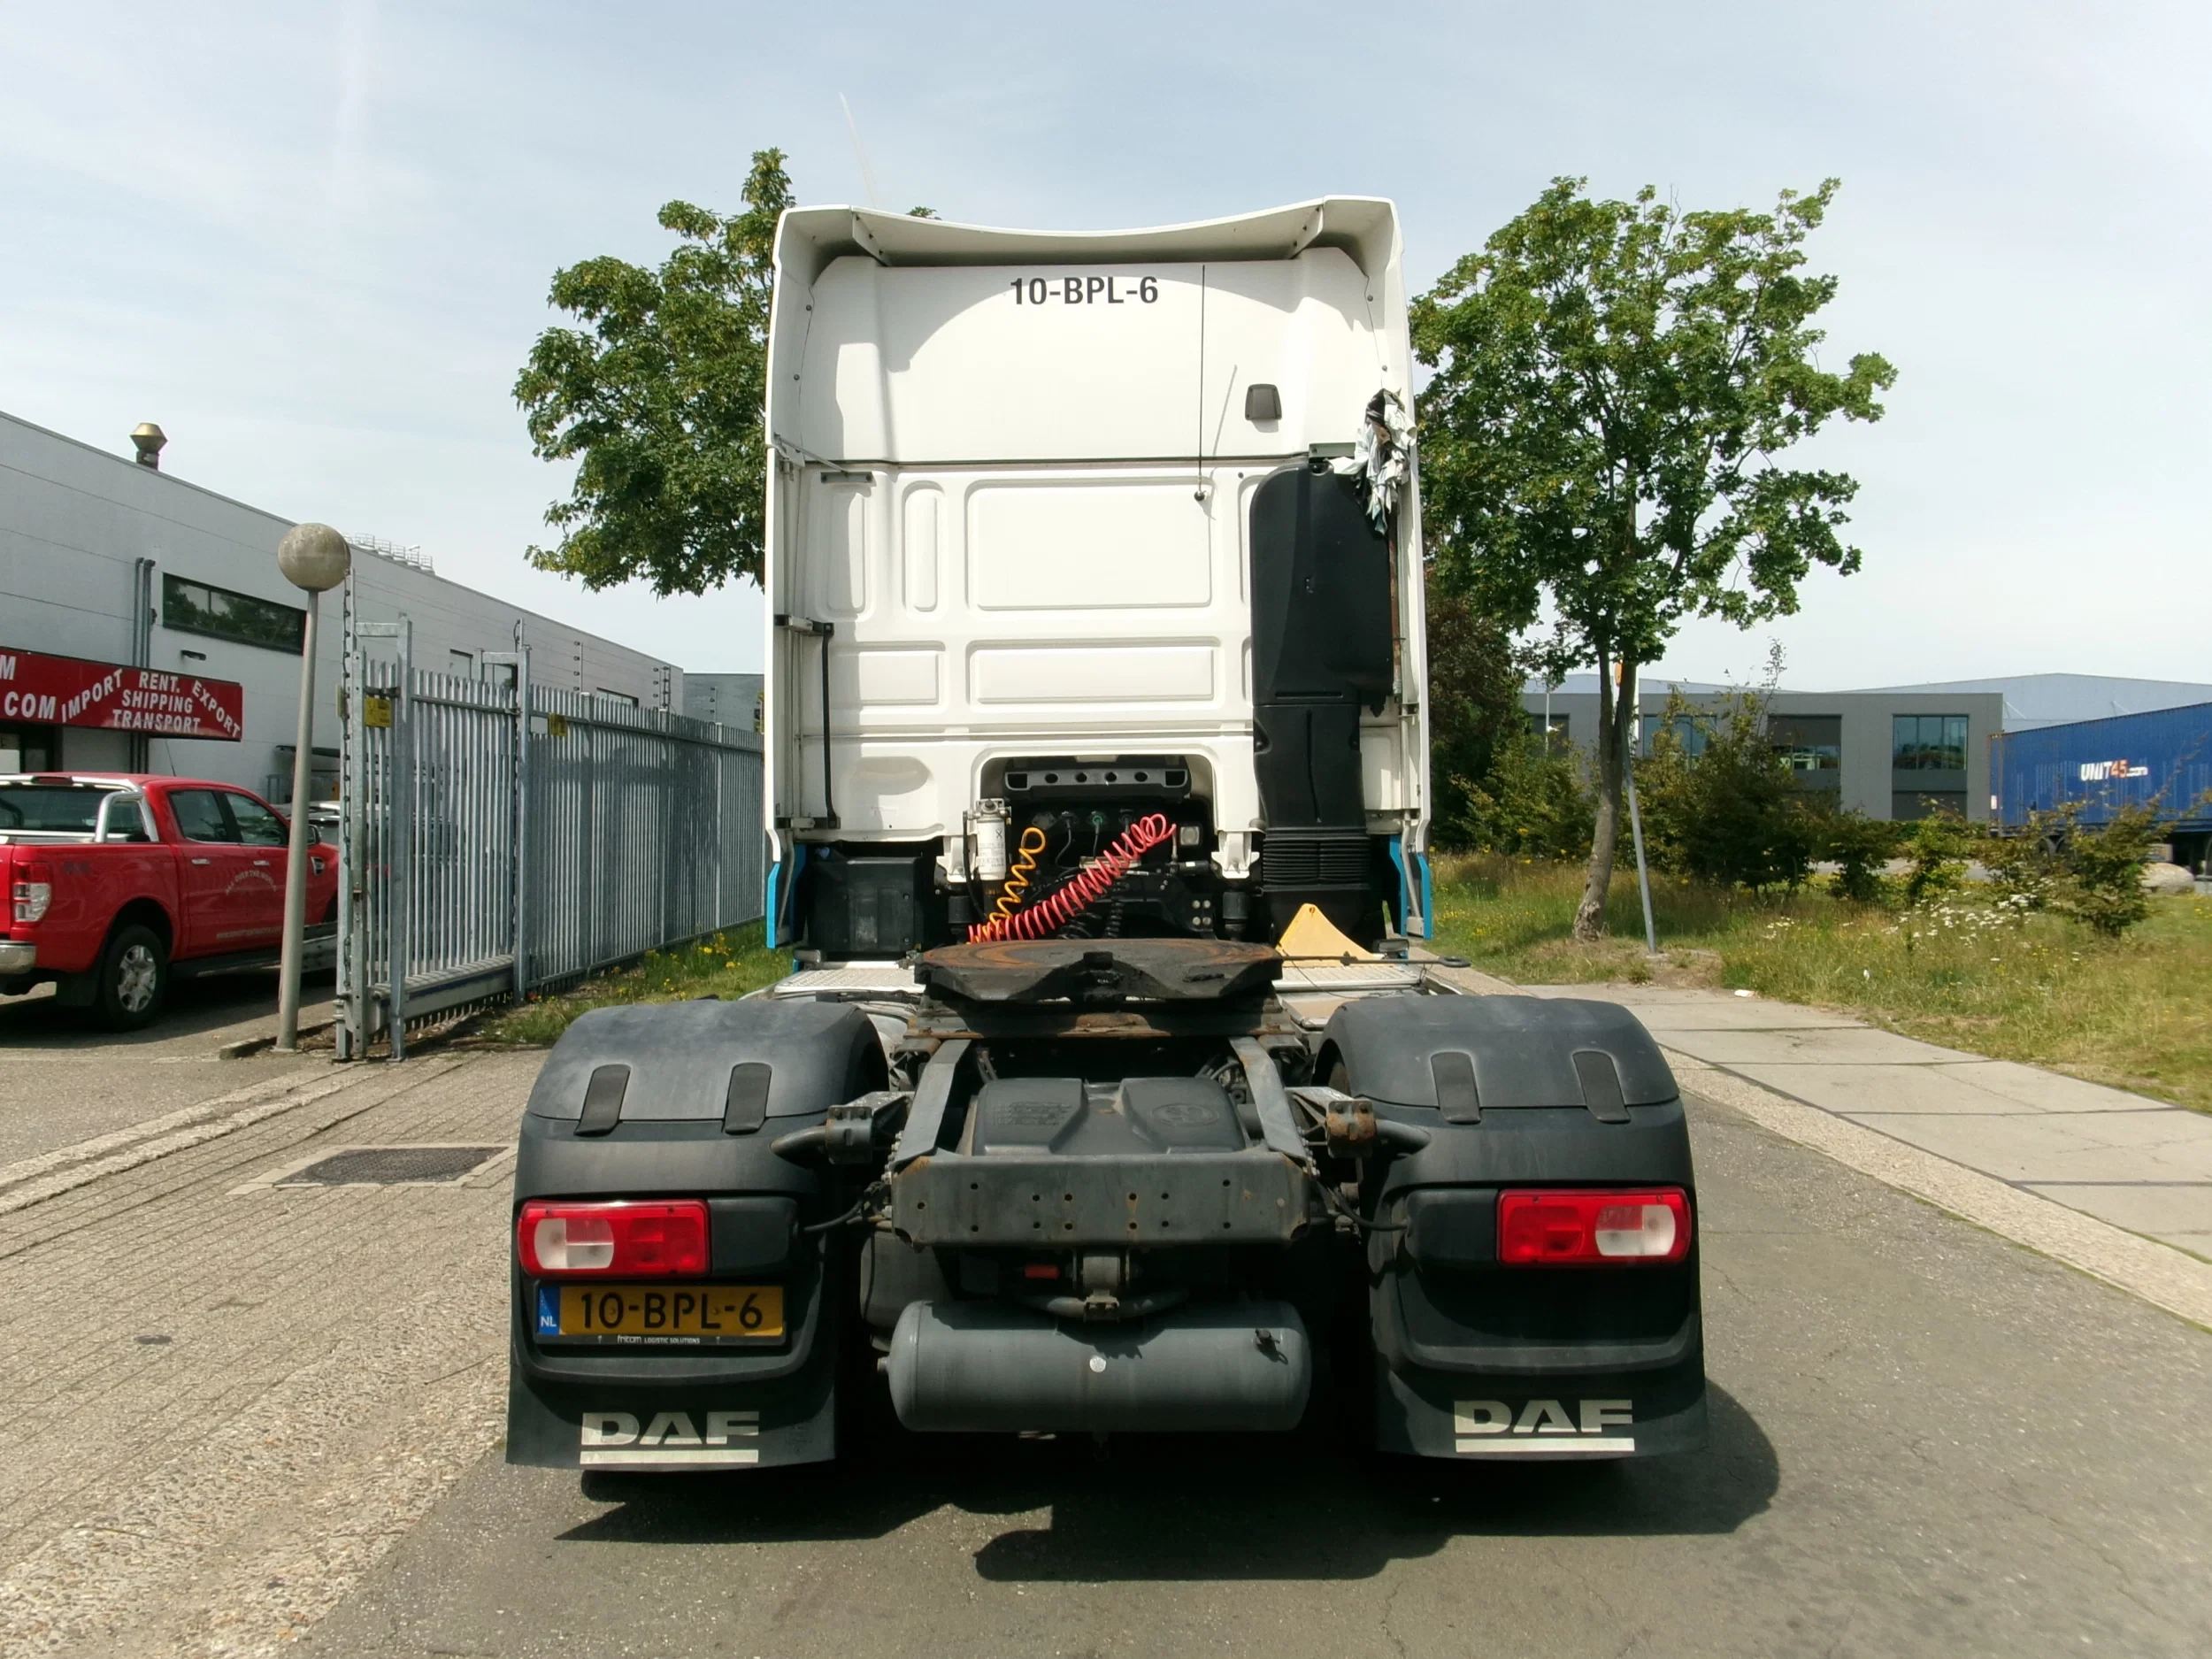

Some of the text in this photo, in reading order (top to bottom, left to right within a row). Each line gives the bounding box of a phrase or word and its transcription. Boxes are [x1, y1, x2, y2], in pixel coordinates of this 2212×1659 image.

[1010, 276, 1159, 305] 10-BPL-6
[61, 668, 123, 724] IMPORT
[139, 672, 180, 694] RENT.
[121, 689, 193, 714] SHIPPING
[192, 680, 241, 738] EXPORT
[112, 709, 202, 733] TRANSPORT
[541, 1315, 557, 1327] NL
[580, 1293, 763, 1329] 10-BPL-6
[580, 1410, 760, 1446] DAF
[1454, 1399, 1633, 1434] DAF
